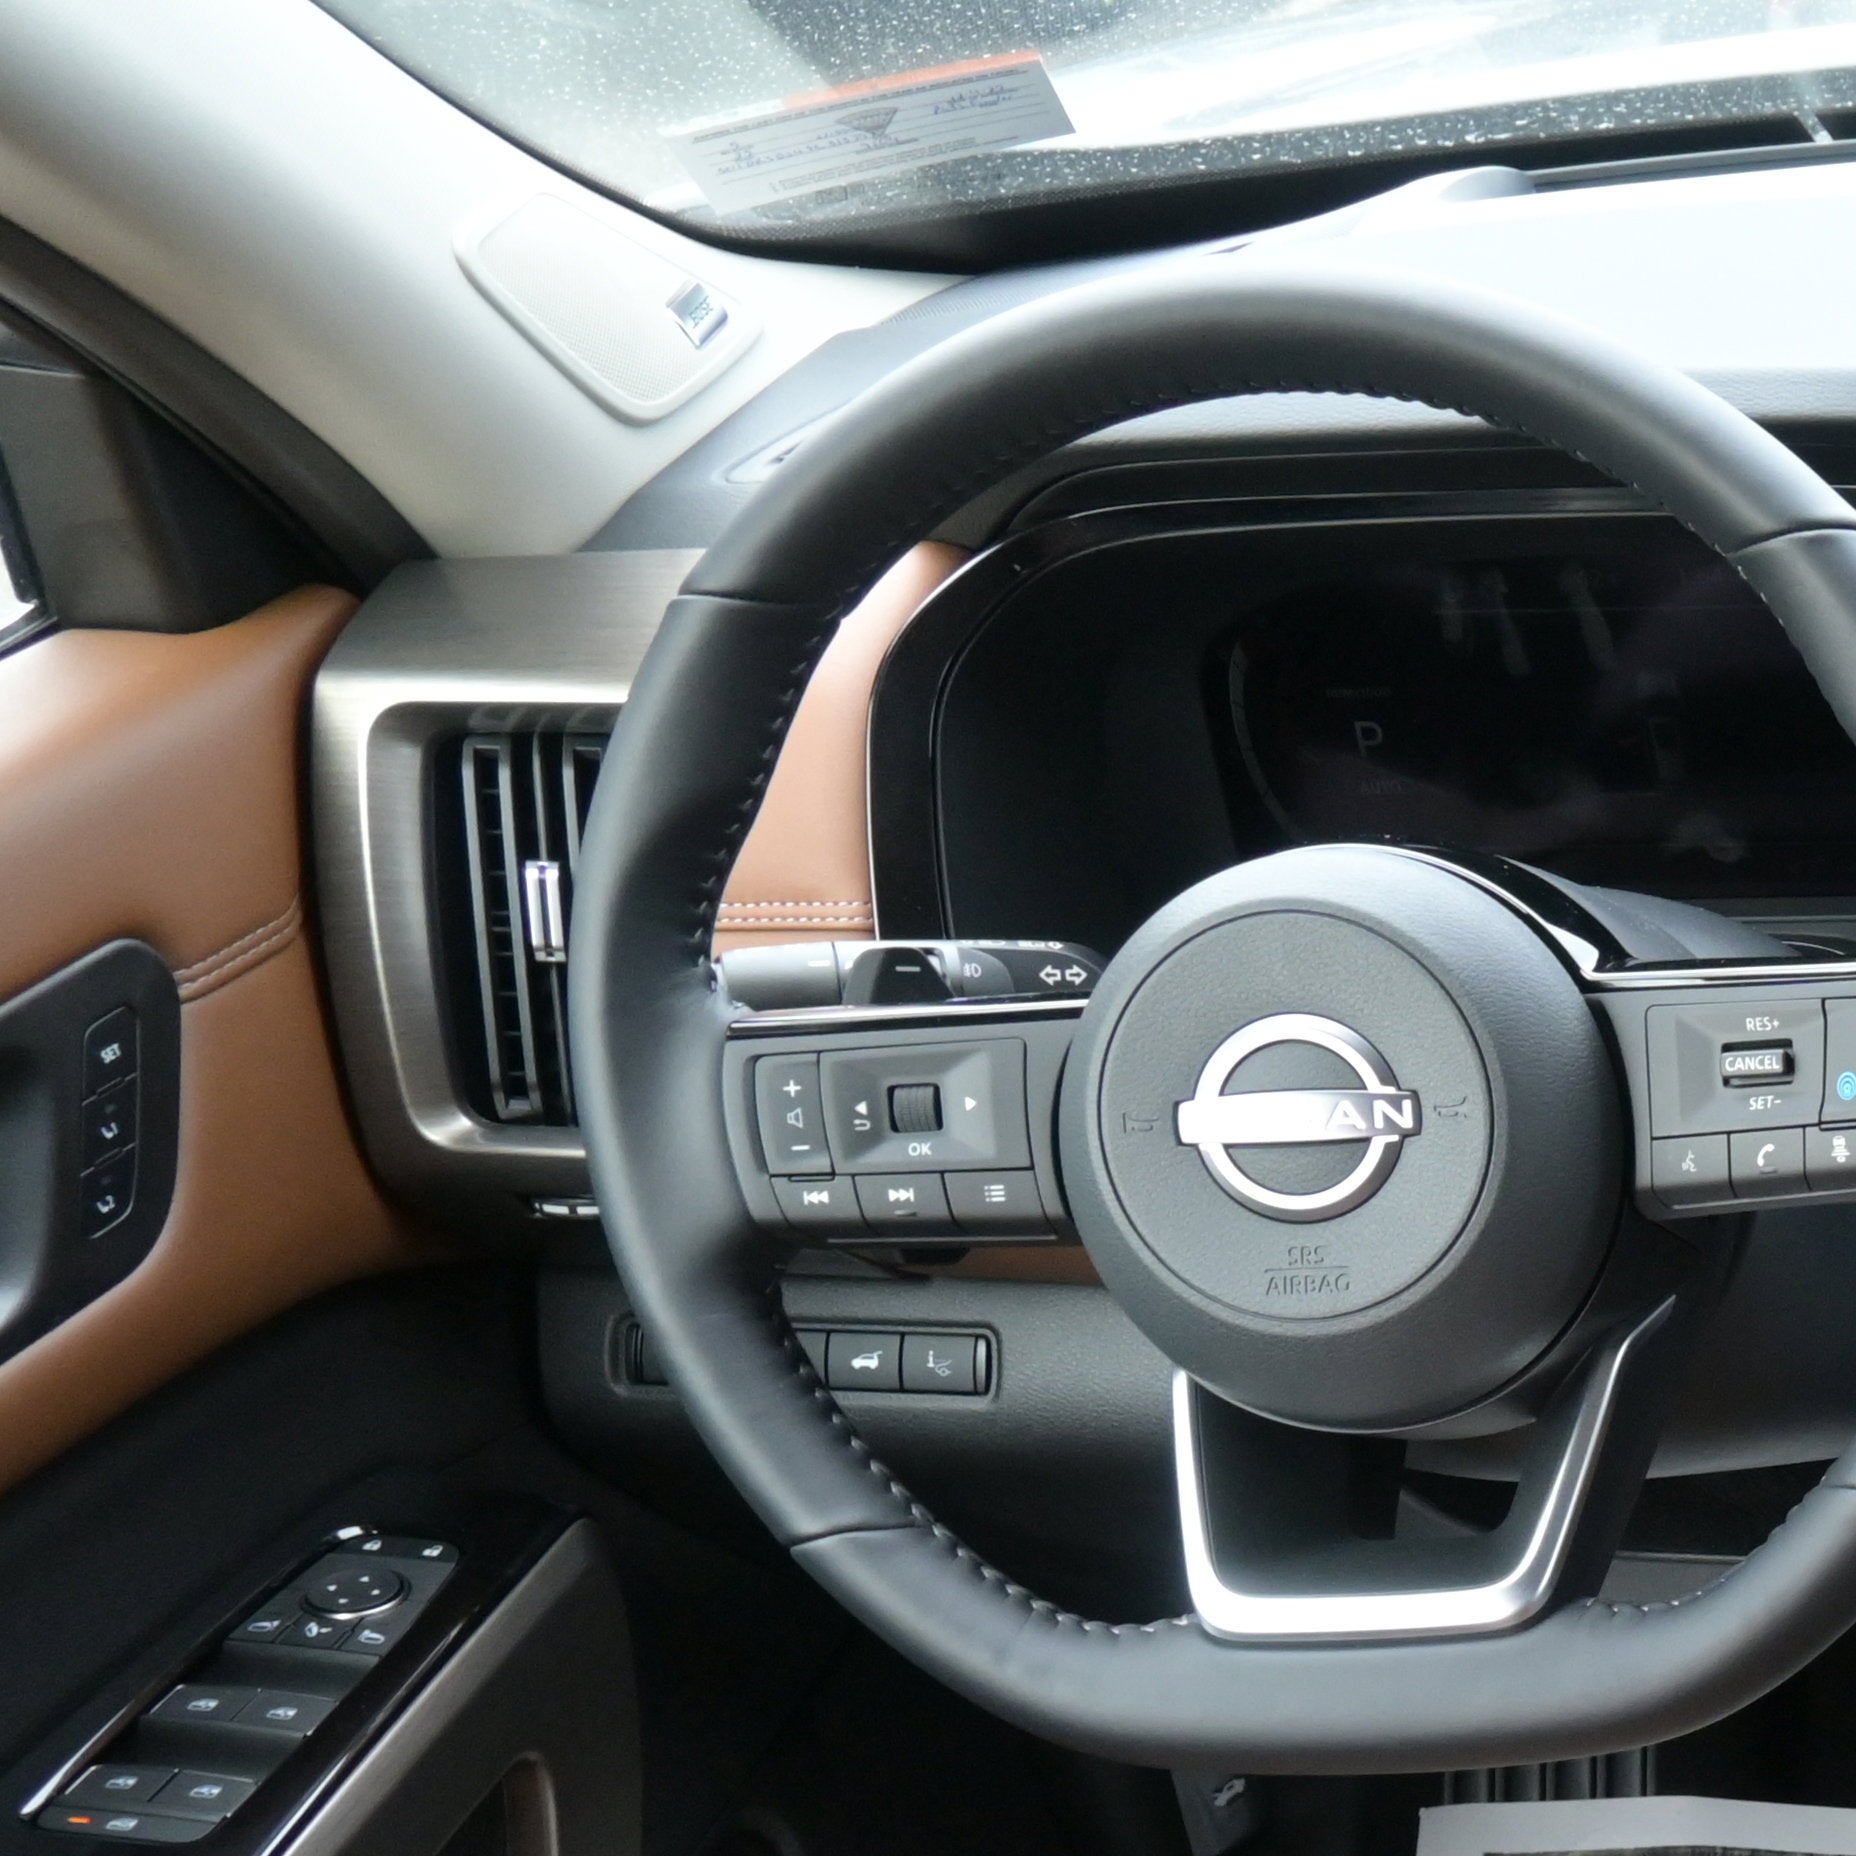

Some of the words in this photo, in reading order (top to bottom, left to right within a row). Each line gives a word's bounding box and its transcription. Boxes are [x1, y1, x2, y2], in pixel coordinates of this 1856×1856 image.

[1745, 1016, 1780, 1031] RES+
[100, 1043, 121, 1063] SET
[1725, 1055, 1780, 1071] CANCEL
[908, 1142, 931, 1156] OK
[1287, 1245, 1325, 1266] SRS
[1266, 1273, 1350, 1296] AIRBAG
